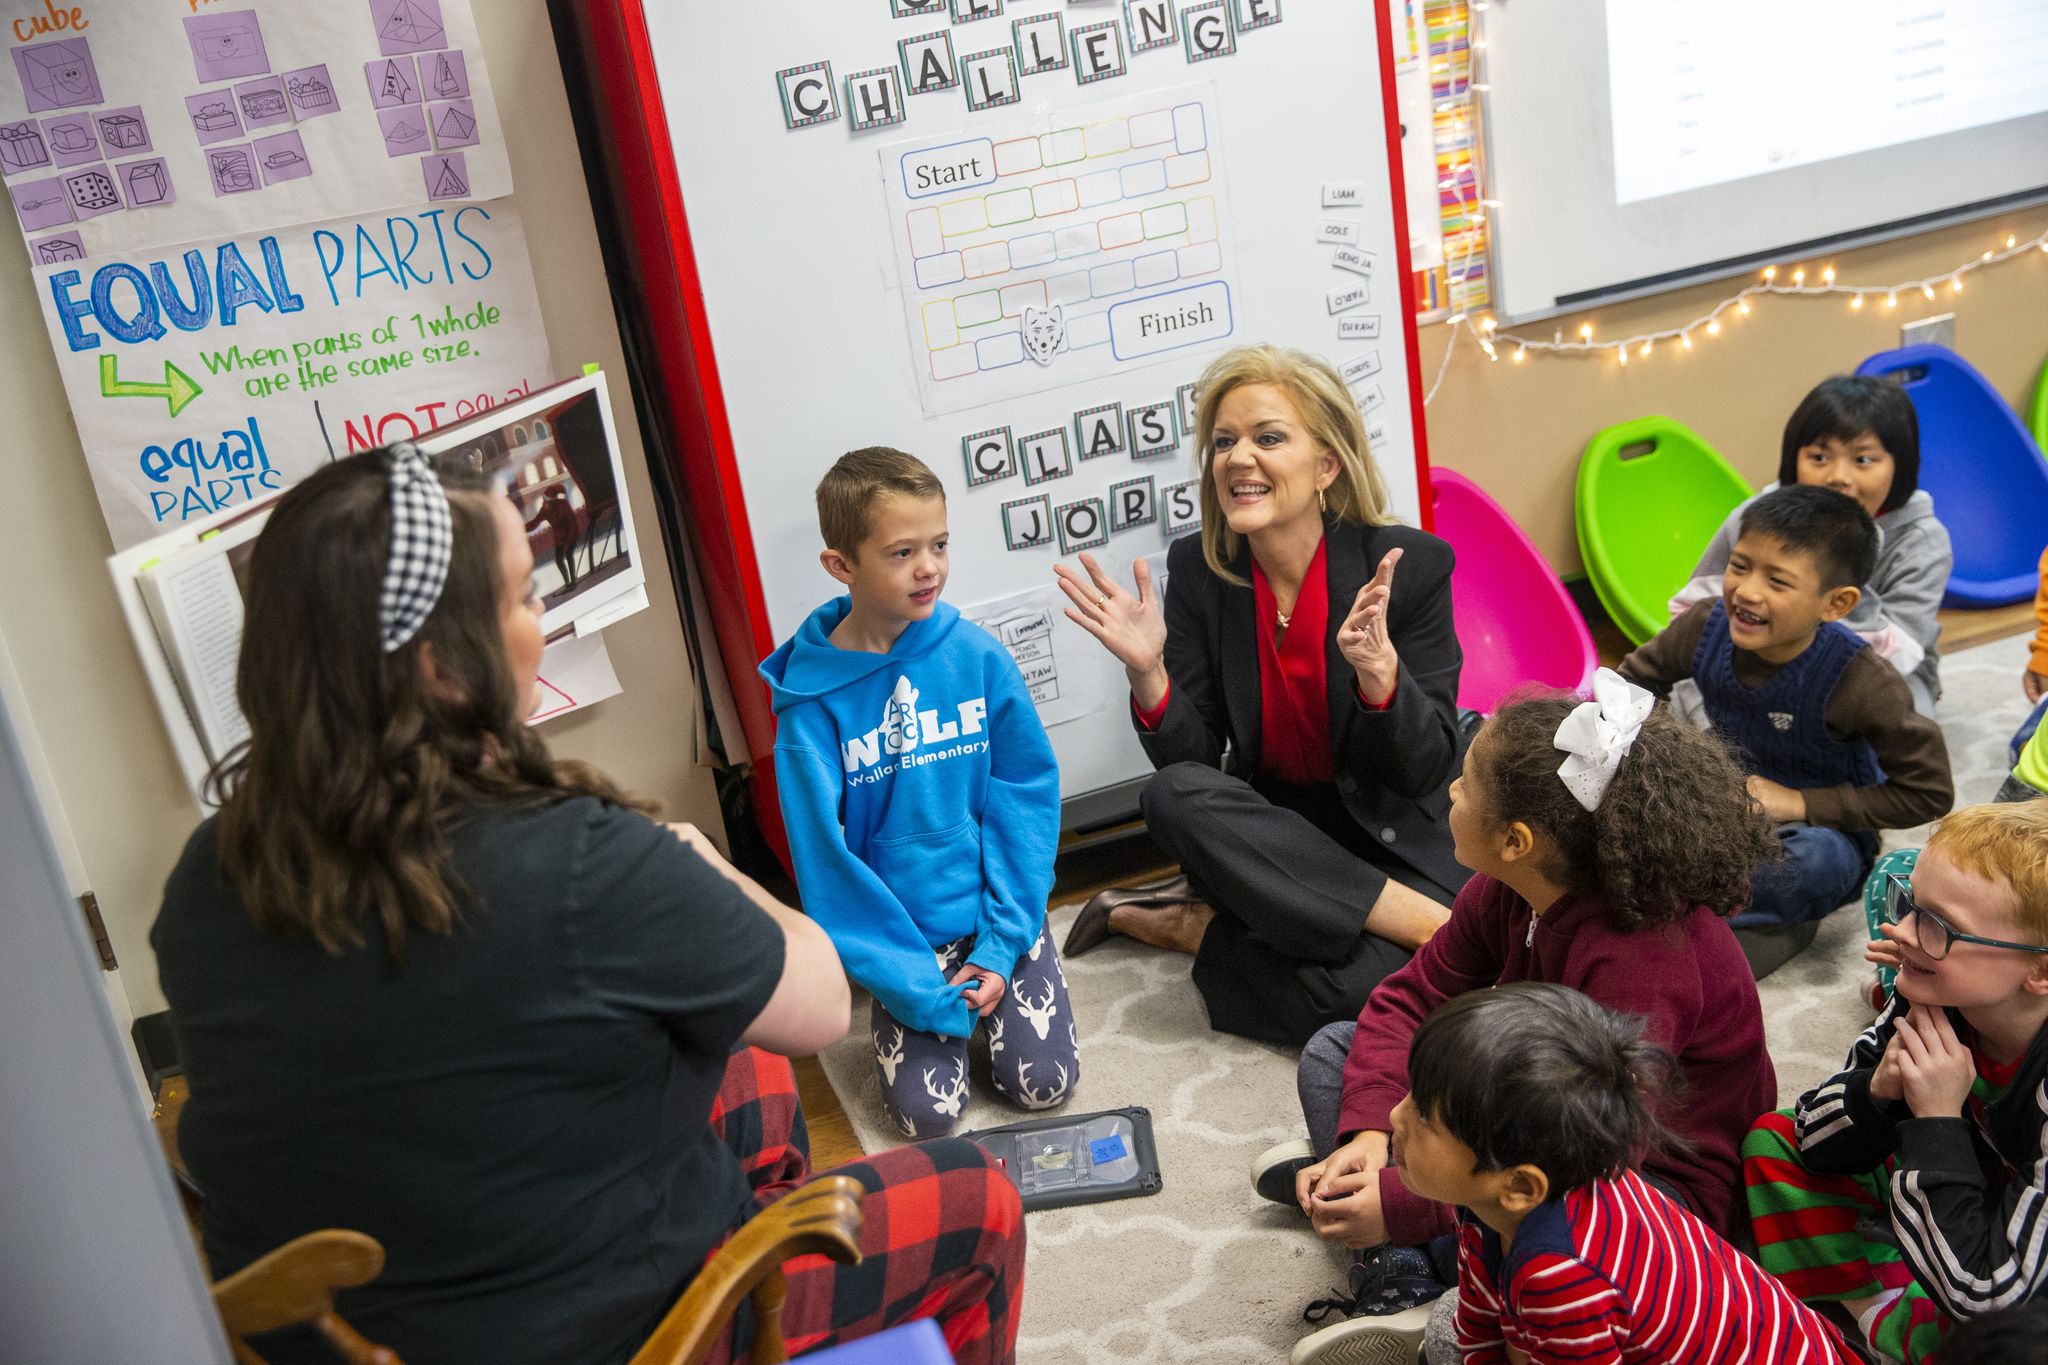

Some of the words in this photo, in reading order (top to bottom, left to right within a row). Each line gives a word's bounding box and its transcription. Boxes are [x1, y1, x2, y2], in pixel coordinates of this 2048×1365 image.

[12, 0, 90, 42] cube
[792, 0, 1270, 123] CHALLENGE
[127, 127, 140, 145] A
[915, 156, 982, 189] Start
[49, 236, 304, 353] EQUAL
[314, 206, 493, 306] PARTS
[200, 345, 289, 375] When
[292, 332, 362, 366] parts
[371, 316, 399, 344] of
[427, 301, 500, 337] whole
[1139, 302, 1214, 337] Finish
[245, 372, 290, 398] are
[298, 361, 338, 391] the
[422, 340, 480, 365] size.
[140, 417, 270, 487] equal
[344, 401, 446, 454] NOT
[1021, 486, 1194, 543] JOBS
[902, 740, 990, 769] Elementary
